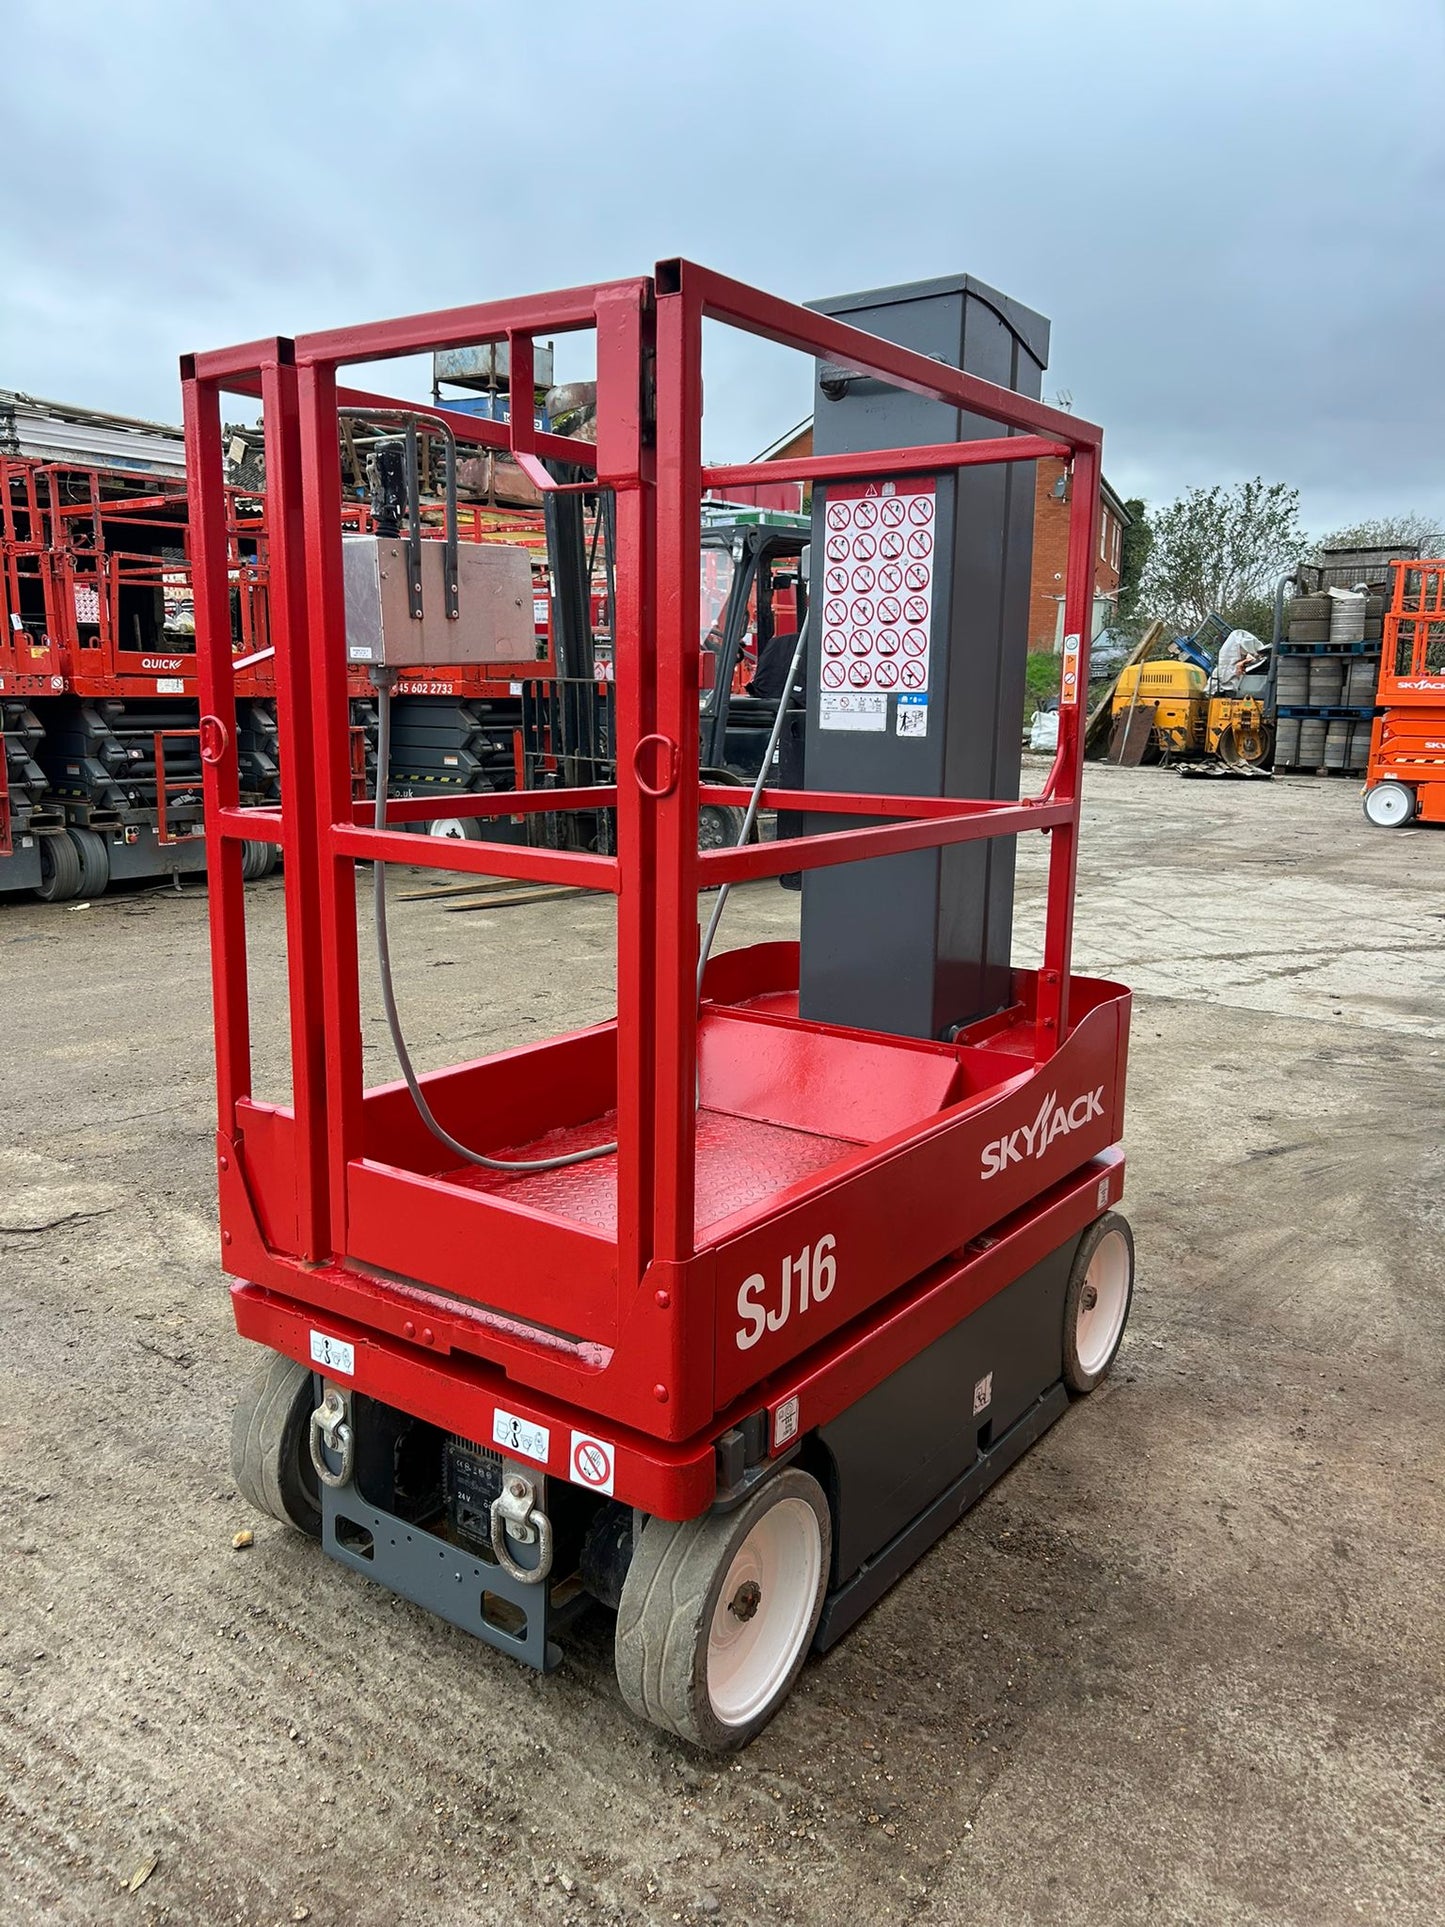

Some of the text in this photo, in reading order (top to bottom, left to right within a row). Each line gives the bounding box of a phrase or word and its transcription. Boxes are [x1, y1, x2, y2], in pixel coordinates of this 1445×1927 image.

[142, 658, 180, 669] QUICK
[400, 683, 453, 694] 45 602 2733
[395, 788, 413, 798] o.uk
[981, 1085, 1104, 1180] SKYJACK
[736, 1233, 836, 1350] SJ16
